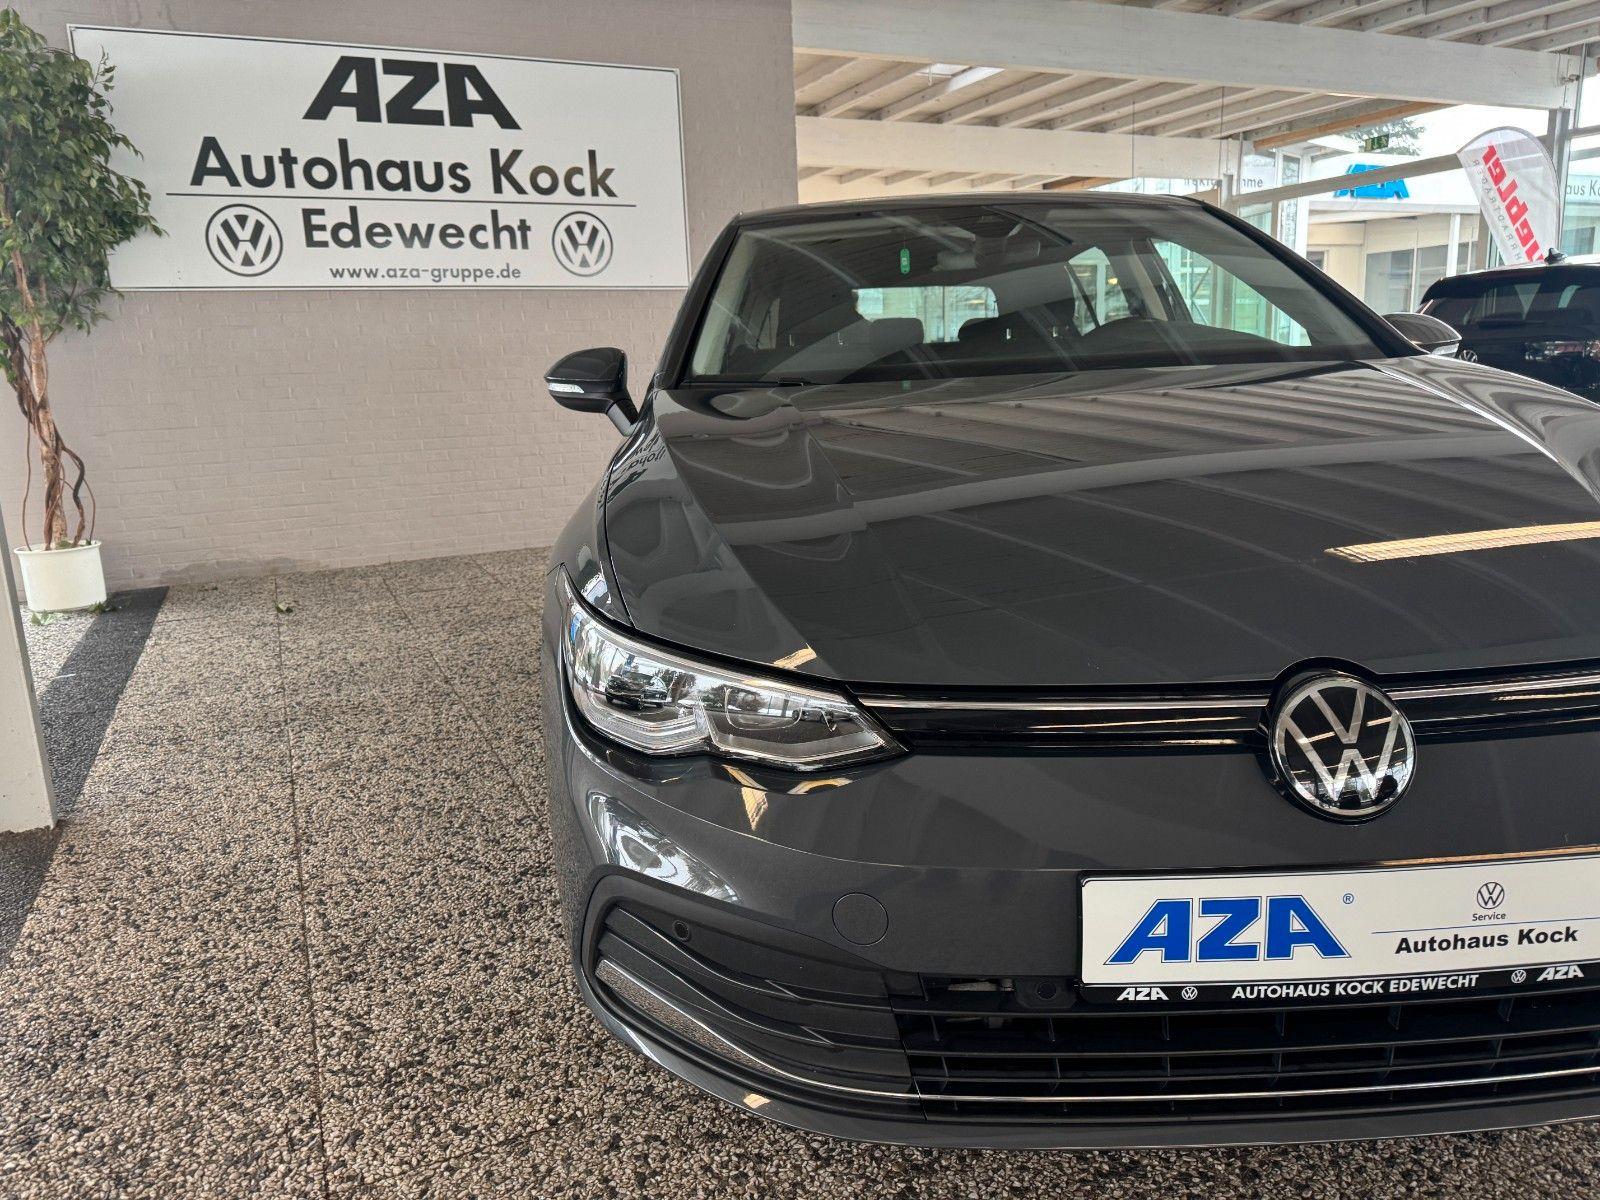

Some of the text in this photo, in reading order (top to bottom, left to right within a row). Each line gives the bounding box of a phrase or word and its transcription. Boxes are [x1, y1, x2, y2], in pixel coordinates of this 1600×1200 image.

[302, 55, 523, 130] AZA
[190, 136, 618, 198] Autohaus Kock
[302, 206, 531, 250] Edewecht
[329, 262, 521, 283] www.aza-gruppe.de
[1103, 895, 1352, 965] AZA
[1472, 912, 1507, 922] Service
[1395, 926, 1579, 954] Autohaus Kock
[1116, 987, 1169, 1001] AZA
[1231, 983, 1330, 999] AUTOHAUS
[1334, 980, 1384, 996] KOCK
[1389, 974, 1480, 993] EDEWECHT
[1536, 964, 1585, 982] AZA
